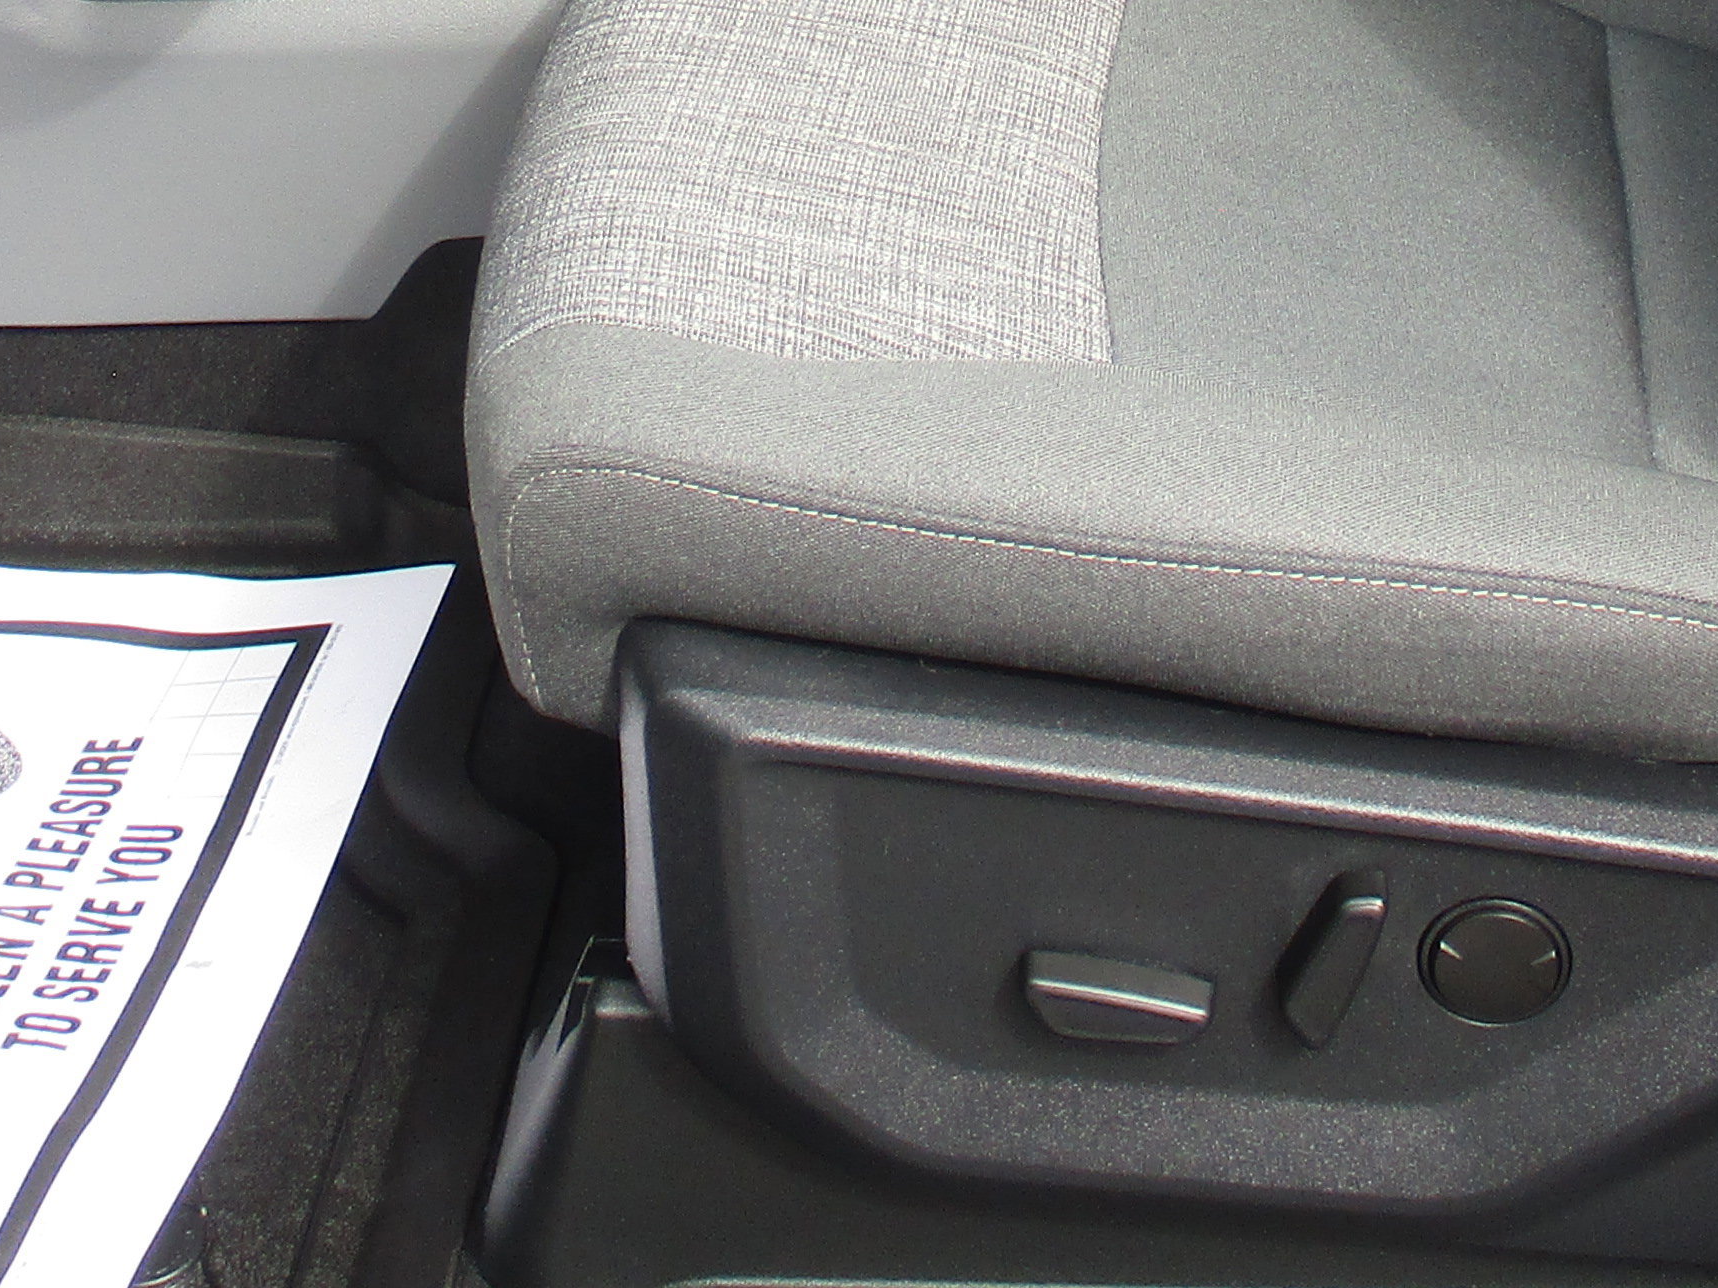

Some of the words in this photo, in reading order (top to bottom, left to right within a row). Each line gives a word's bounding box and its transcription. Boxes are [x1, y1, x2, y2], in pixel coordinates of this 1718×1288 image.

[3, 736, 144, 892] PLEASURE
[96, 825, 184, 885] YOU
[32, 898, 146, 1003] SERVE
[0, 1012, 83, 1051] TO
